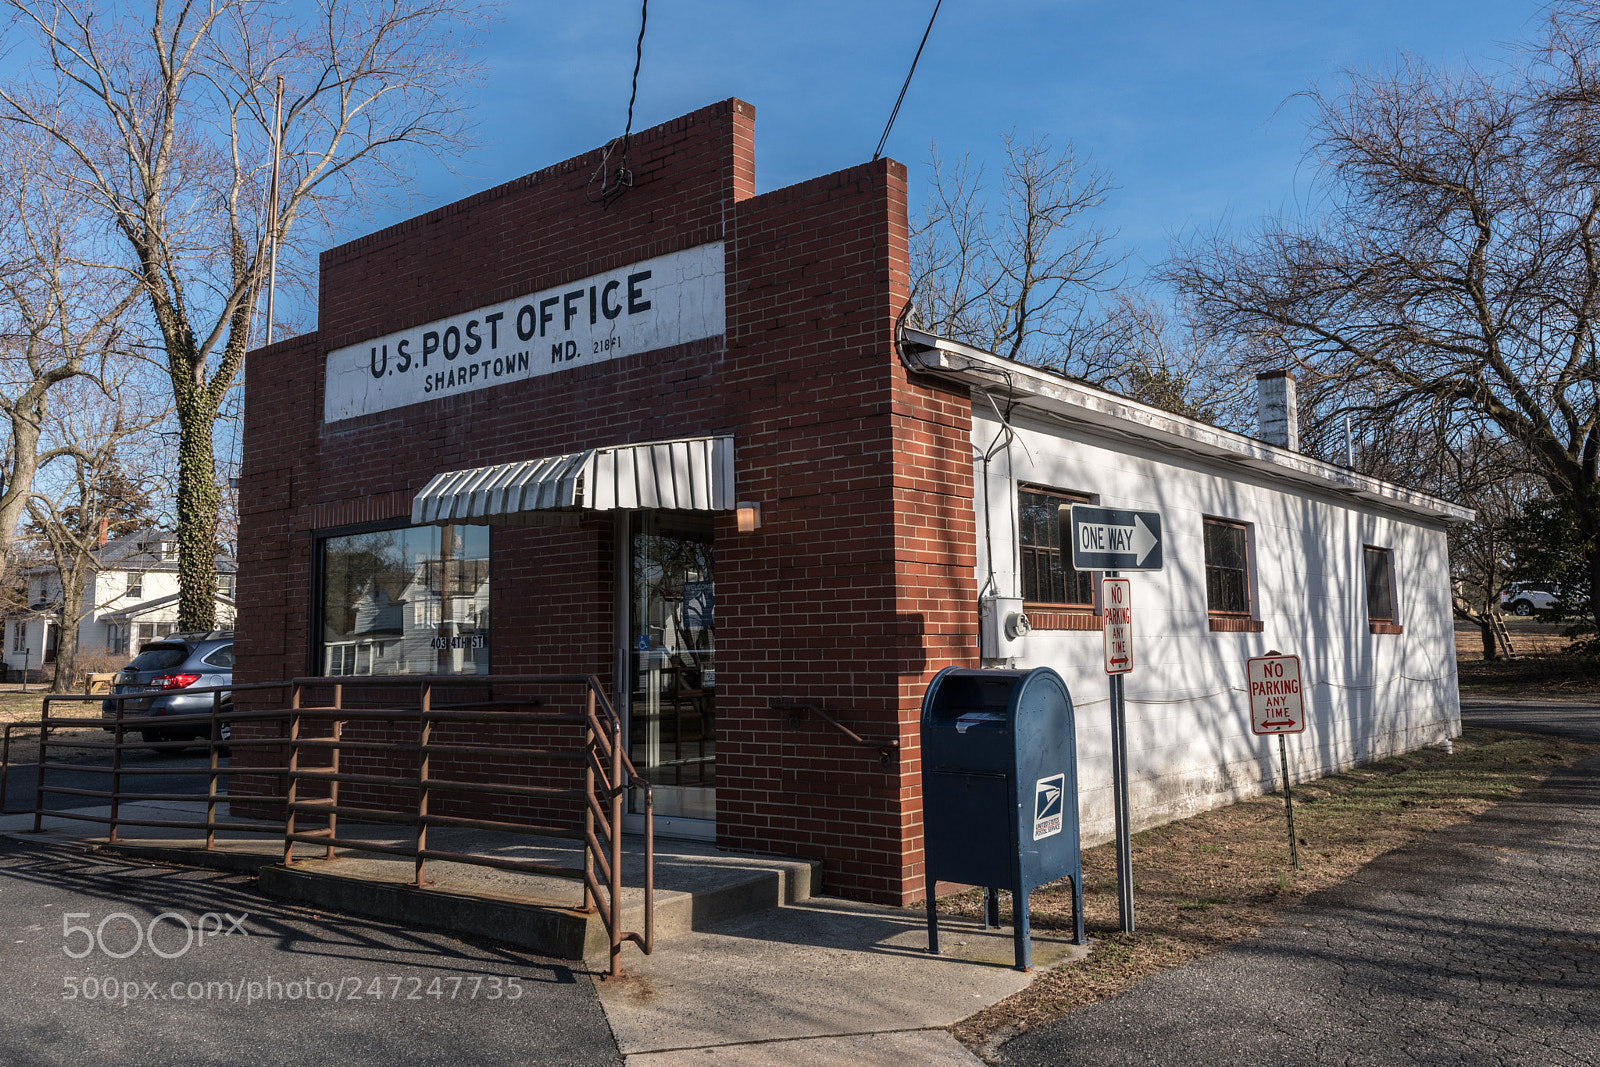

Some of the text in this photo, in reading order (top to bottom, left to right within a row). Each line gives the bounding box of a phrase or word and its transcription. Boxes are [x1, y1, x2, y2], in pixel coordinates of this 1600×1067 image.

[516, 269, 652, 342] OFFICE
[424, 350, 529, 393] SHARPTOWN
[551, 340, 581, 364] MD.
[1082, 525, 1133, 551] ONE WAY
[1111, 586, 1122, 604] NO
[1105, 607, 1130, 625] PARKING
[1112, 627, 1124, 639] ANY
[430, 635, 484, 649] 403 4TH ST
[1112, 641, 1126, 654] TIME
[1263, 663, 1284, 678] NO
[1252, 679, 1299, 696] PARKING
[1266, 696, 1287, 707] ANY
[1265, 707, 1290, 719] TIME
